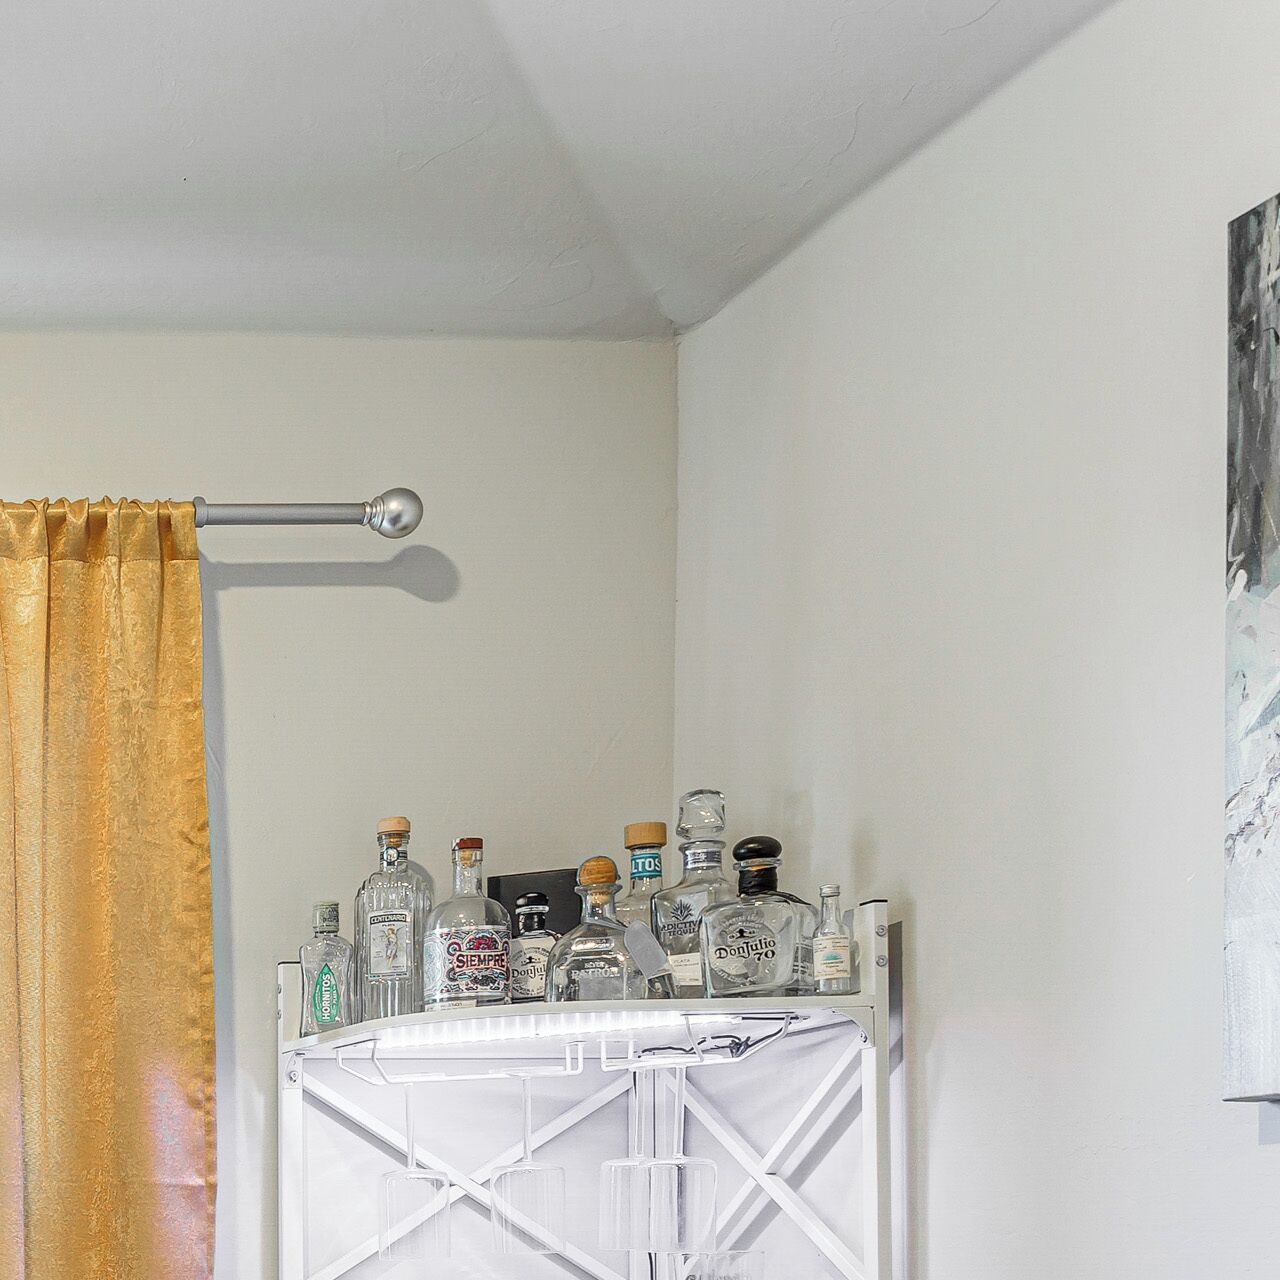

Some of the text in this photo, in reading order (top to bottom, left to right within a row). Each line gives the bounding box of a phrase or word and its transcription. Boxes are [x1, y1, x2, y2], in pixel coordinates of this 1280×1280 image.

[631, 857, 661, 873] LTOS
[660, 920, 698, 932] ADICTIV
[667, 927, 699, 937] TEQUIL
[456, 953, 506, 969] SIEMPRE
[753, 949, 776, 962] 70
[322, 973, 331, 1020] HORNITOS
